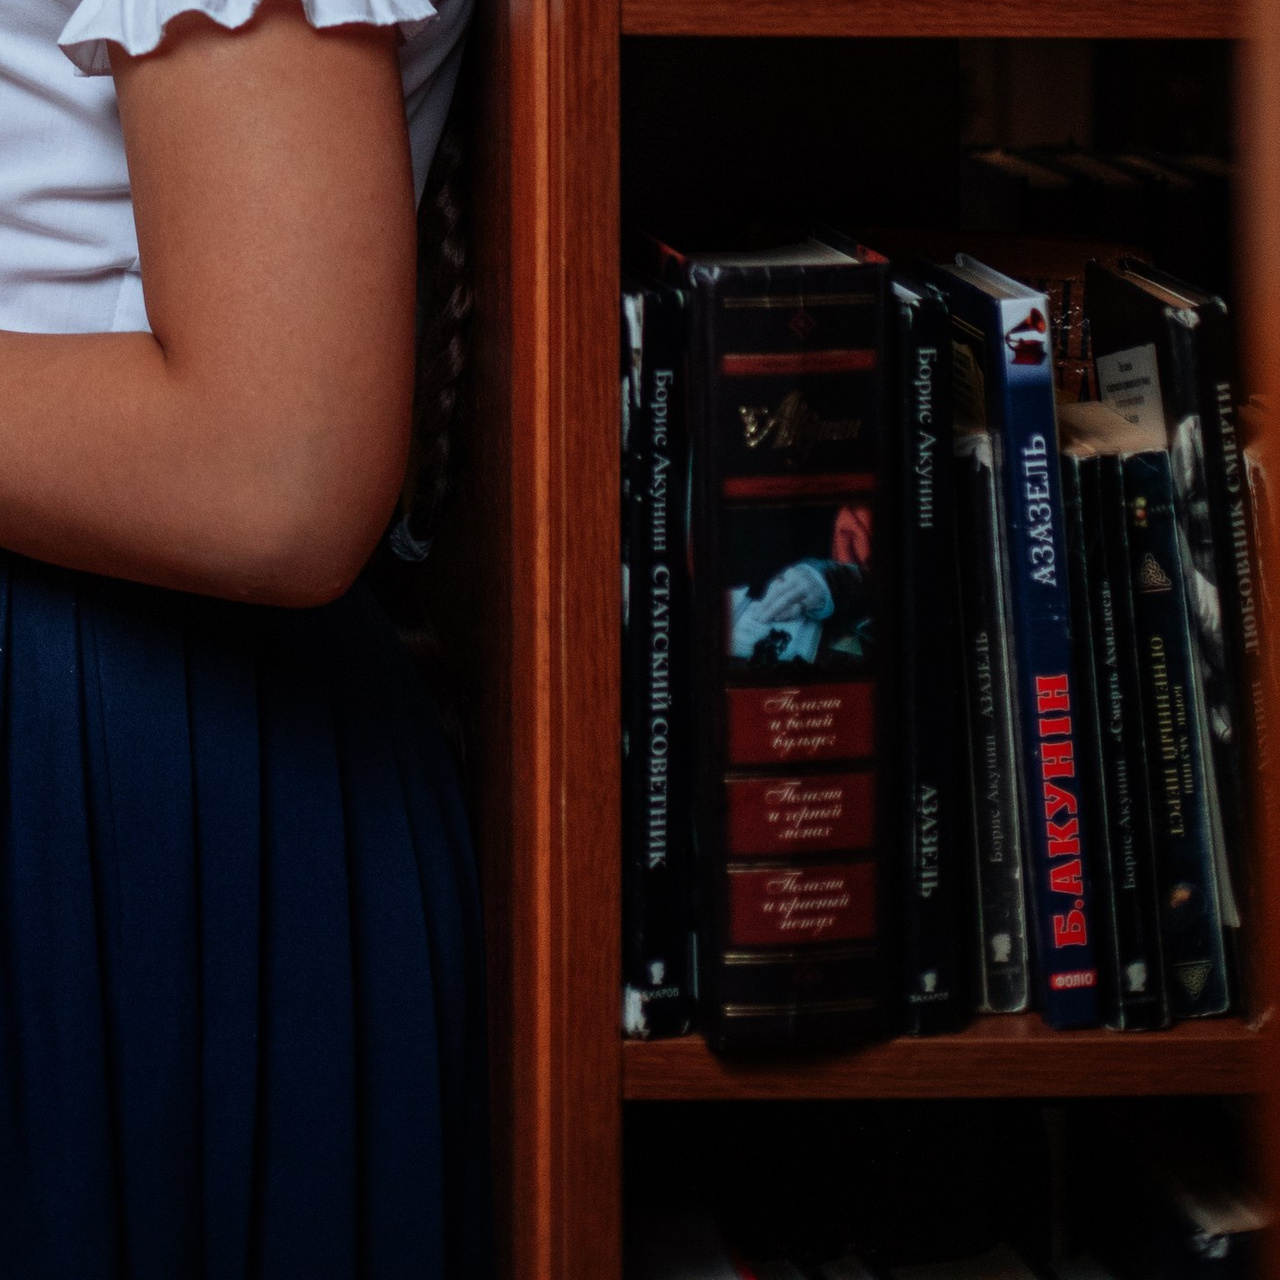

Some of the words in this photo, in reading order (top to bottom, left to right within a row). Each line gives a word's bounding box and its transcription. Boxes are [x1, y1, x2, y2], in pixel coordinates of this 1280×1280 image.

[650, 368, 674, 446] Борис
[915, 346, 939, 424] Борис
[1214, 381, 1242, 495] СМЕРТИ
[649, 452, 673, 552] Акунин
[915, 430, 938, 528] Акунин
[1022, 434, 1058, 588] АЗАЗЕЛЬ
[649, 564, 673, 711] СТАТСКИЙ
[1148, 635, 1178, 761] ОГНЕННЫЙ
[647, 717, 670, 870] СОВЕТНИК
[919, 783, 940, 899] АЗАЗЕЛЬ
[1035, 673, 1088, 949] Б.АКУНІН
